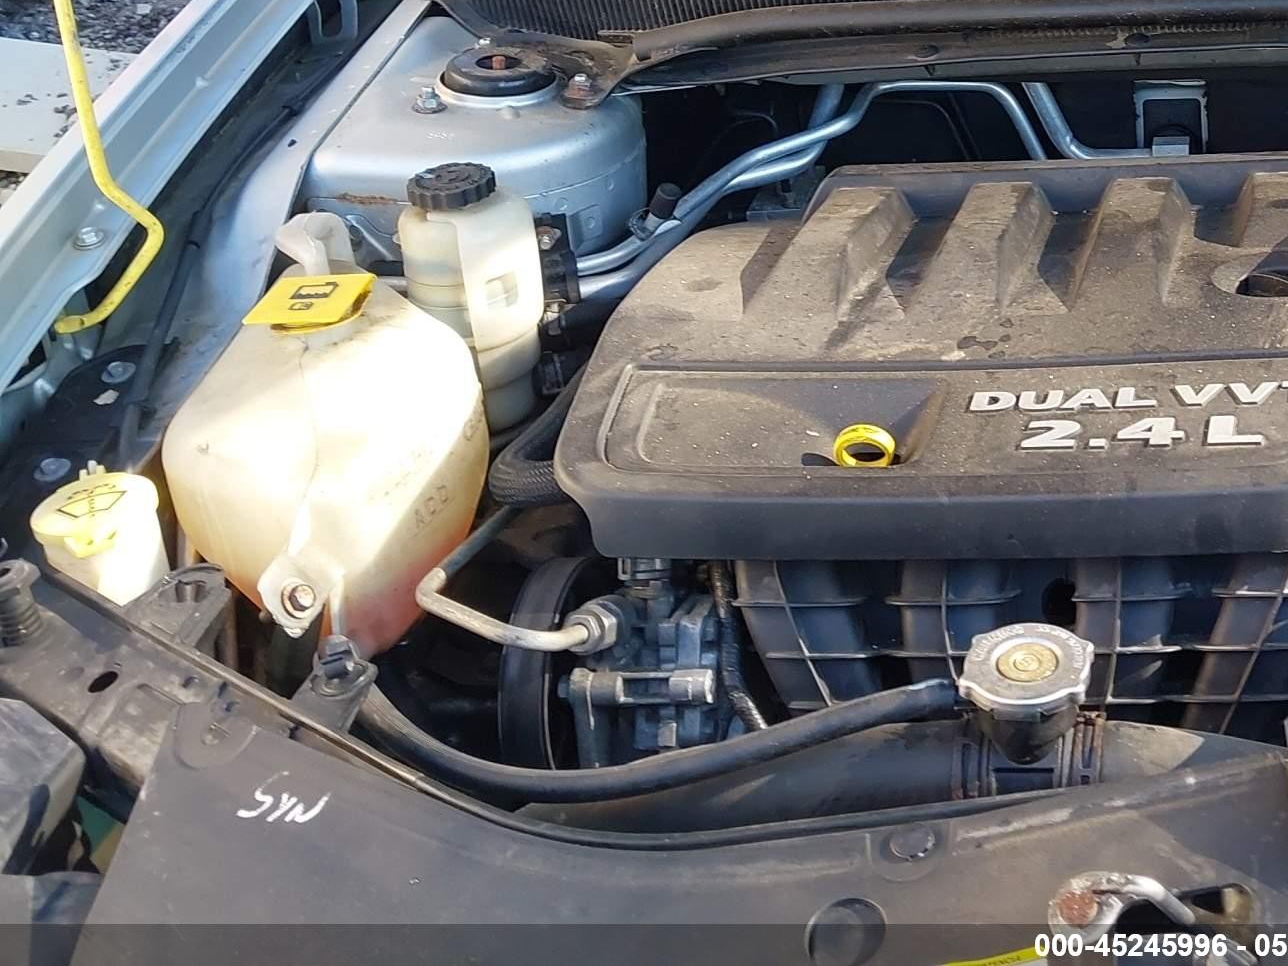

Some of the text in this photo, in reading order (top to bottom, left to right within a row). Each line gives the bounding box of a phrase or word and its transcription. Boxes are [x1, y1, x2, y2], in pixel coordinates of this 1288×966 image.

[968, 386, 1158, 412] DUAL
[1018, 414, 1266, 450] 2.4 L
